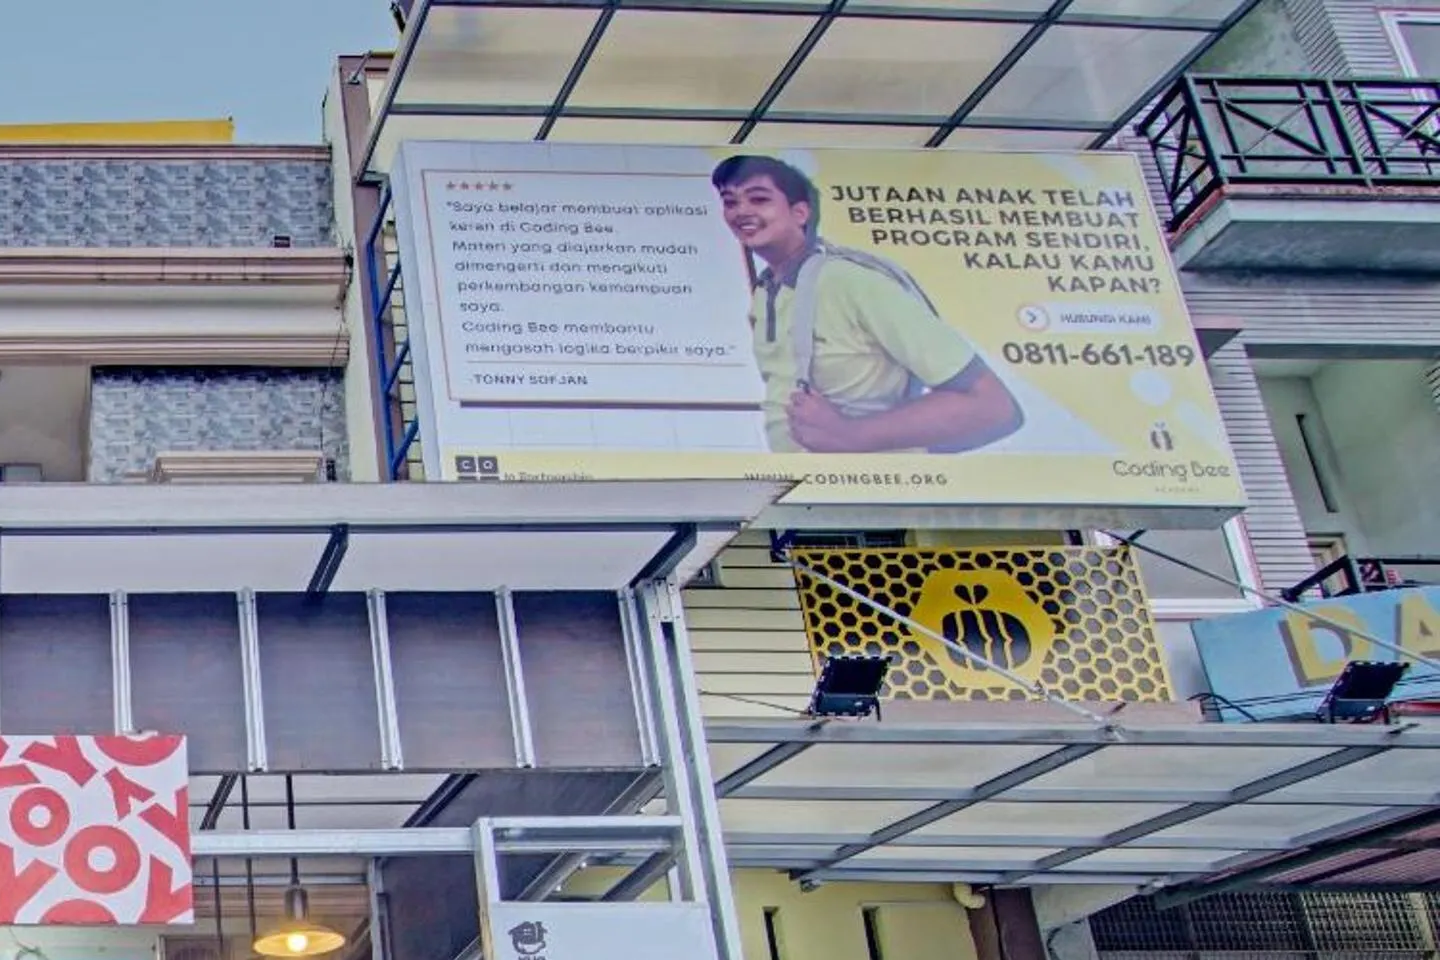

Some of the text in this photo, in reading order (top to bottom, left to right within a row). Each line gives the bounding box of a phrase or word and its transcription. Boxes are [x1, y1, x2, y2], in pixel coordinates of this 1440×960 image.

[830, 185, 1135, 208] JUTAAN ANAK TELAH
[498, 202, 557, 216] belajar
[562, 203, 639, 215] membuat
[645, 204, 708, 218] aplikasi
[848, 206, 1140, 228] BERHASIL MEMBUAT
[520, 221, 580, 235] Coding
[872, 229, 1018, 248] PROGRAM
[510, 242, 553, 255] yang
[641, 243, 698, 256] mudah
[549, 261, 581, 273] dan
[963, 252, 1154, 272] KALAU KAMU
[457, 280, 693, 296] perkembangan kemampuan
[1047, 275, 1161, 294] KAPAN?
[462, 321, 523, 334] Coding
[1002, 342, 1195, 367] 0811-661-189
